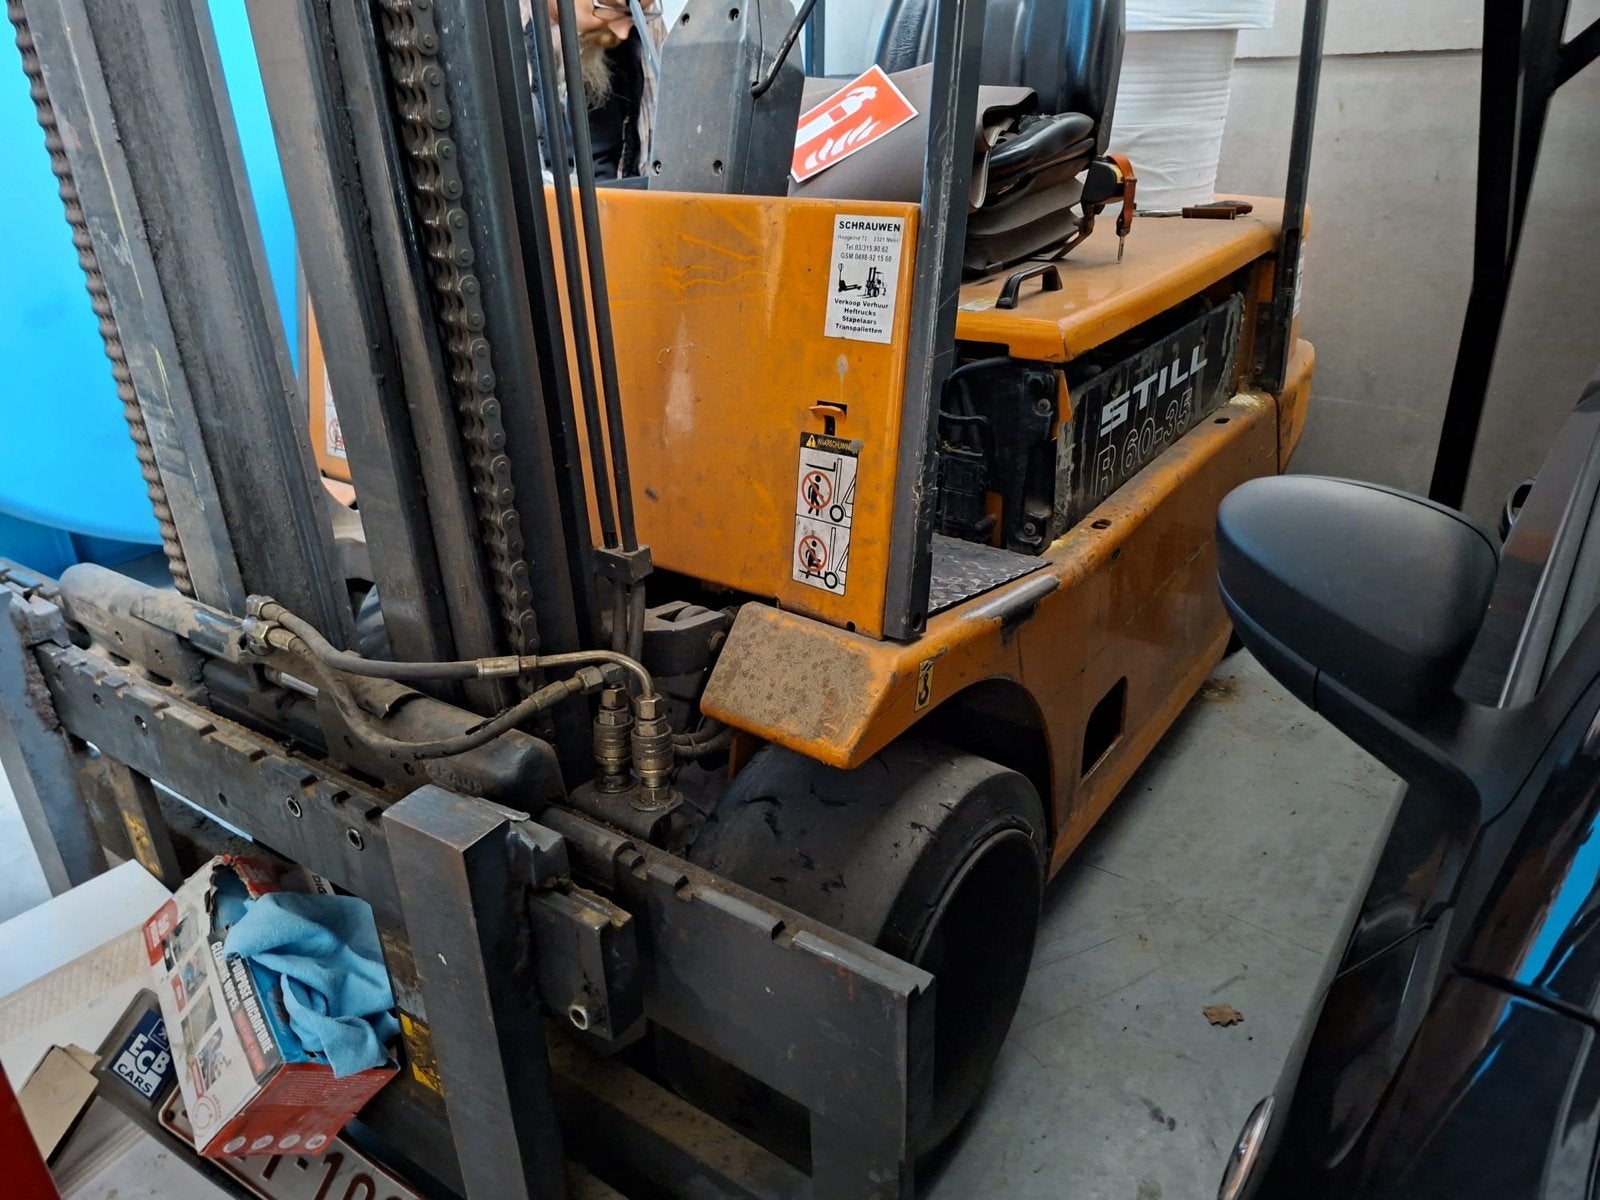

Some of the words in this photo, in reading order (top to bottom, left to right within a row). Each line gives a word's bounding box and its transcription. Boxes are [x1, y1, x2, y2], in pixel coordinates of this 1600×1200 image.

[838, 220, 901, 232] SCHRAUWEN
[846, 243, 854, 251] Tel
[841, 252, 854, 260] GSM
[834, 297, 861, 307] Verkoop
[862, 300, 889, 309] Verhuur
[844, 307, 876, 316] Heftrucks
[842, 315, 877, 325] Stapelaars
[835, 322, 883, 334] Transpalletten
[1100, 345, 1208, 438] STILL
[1095, 444, 1117, 498] R
[1121, 387, 1193, 477] 60-35
[223, 978, 240, 1012] WIPES
[243, 995, 274, 1055] MICROFIBRE
[129, 1032, 171, 1075] ECB
[117, 1063, 153, 1093] CARS
